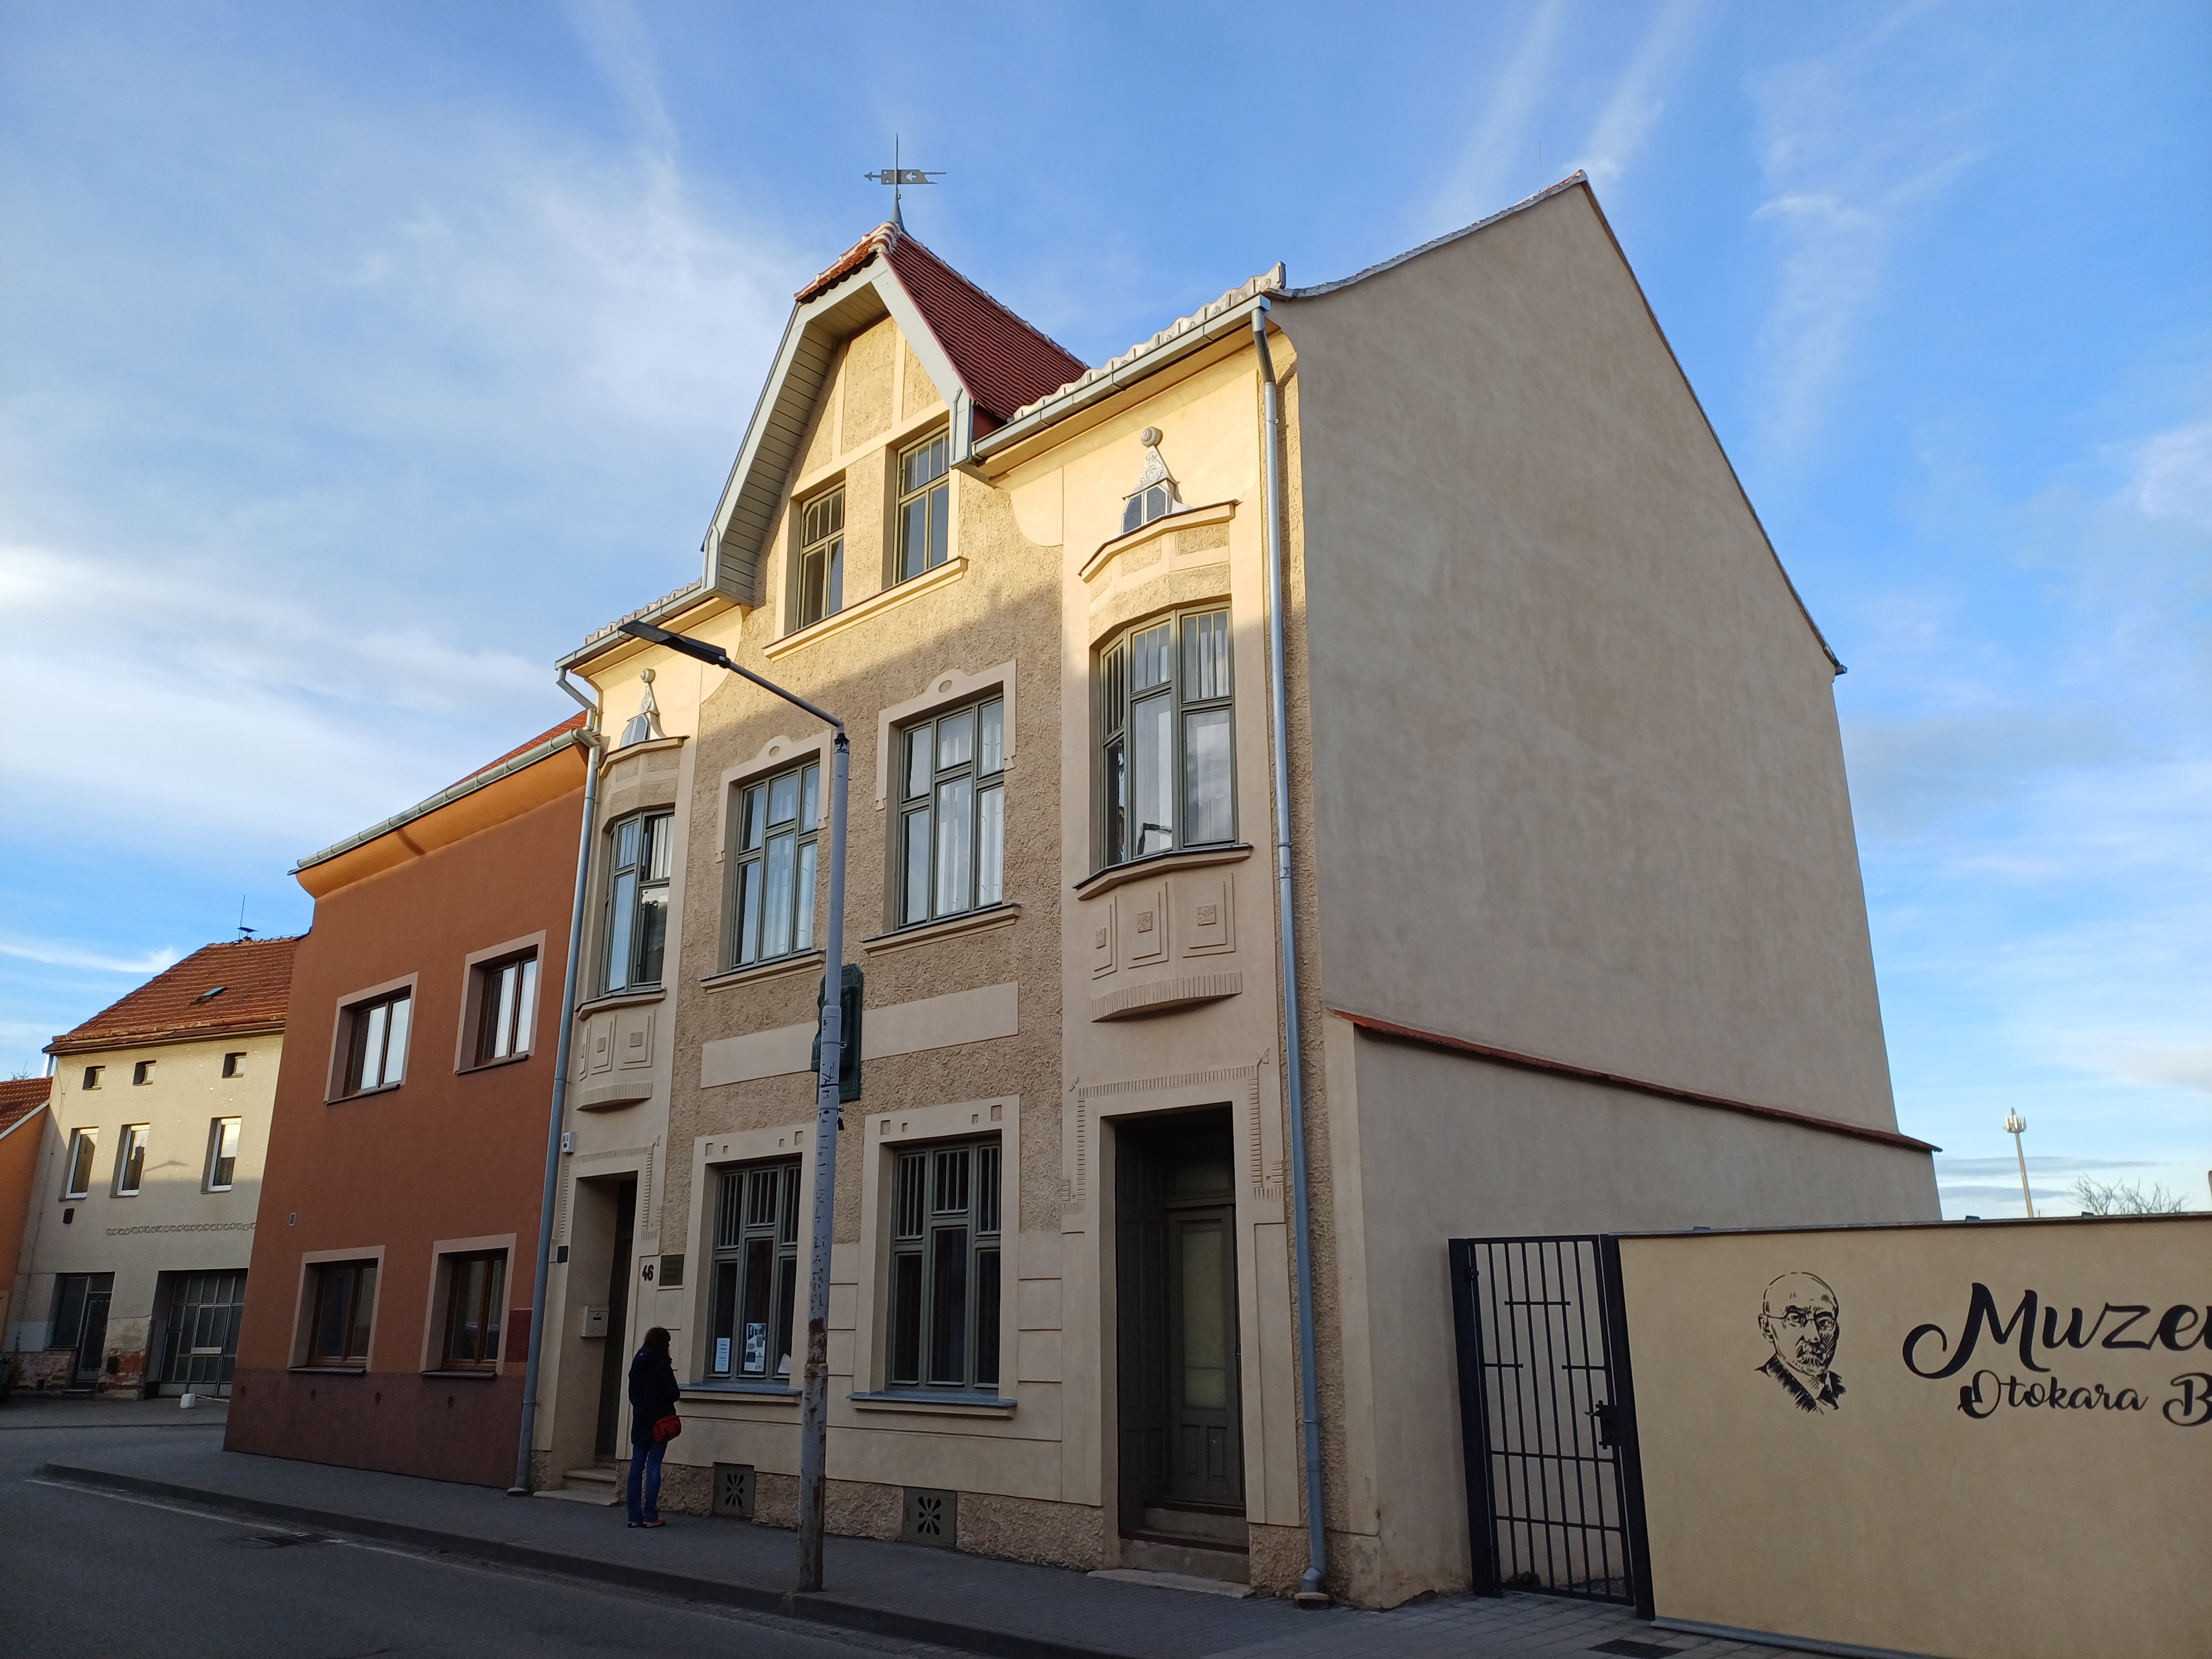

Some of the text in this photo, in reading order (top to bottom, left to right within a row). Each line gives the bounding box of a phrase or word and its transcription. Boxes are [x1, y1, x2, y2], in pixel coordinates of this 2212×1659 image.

[641, 1264, 654, 1282] 46
[1902, 1282, 2212, 1380] Muze
[1958, 1369, 2149, 1419] Otokara
